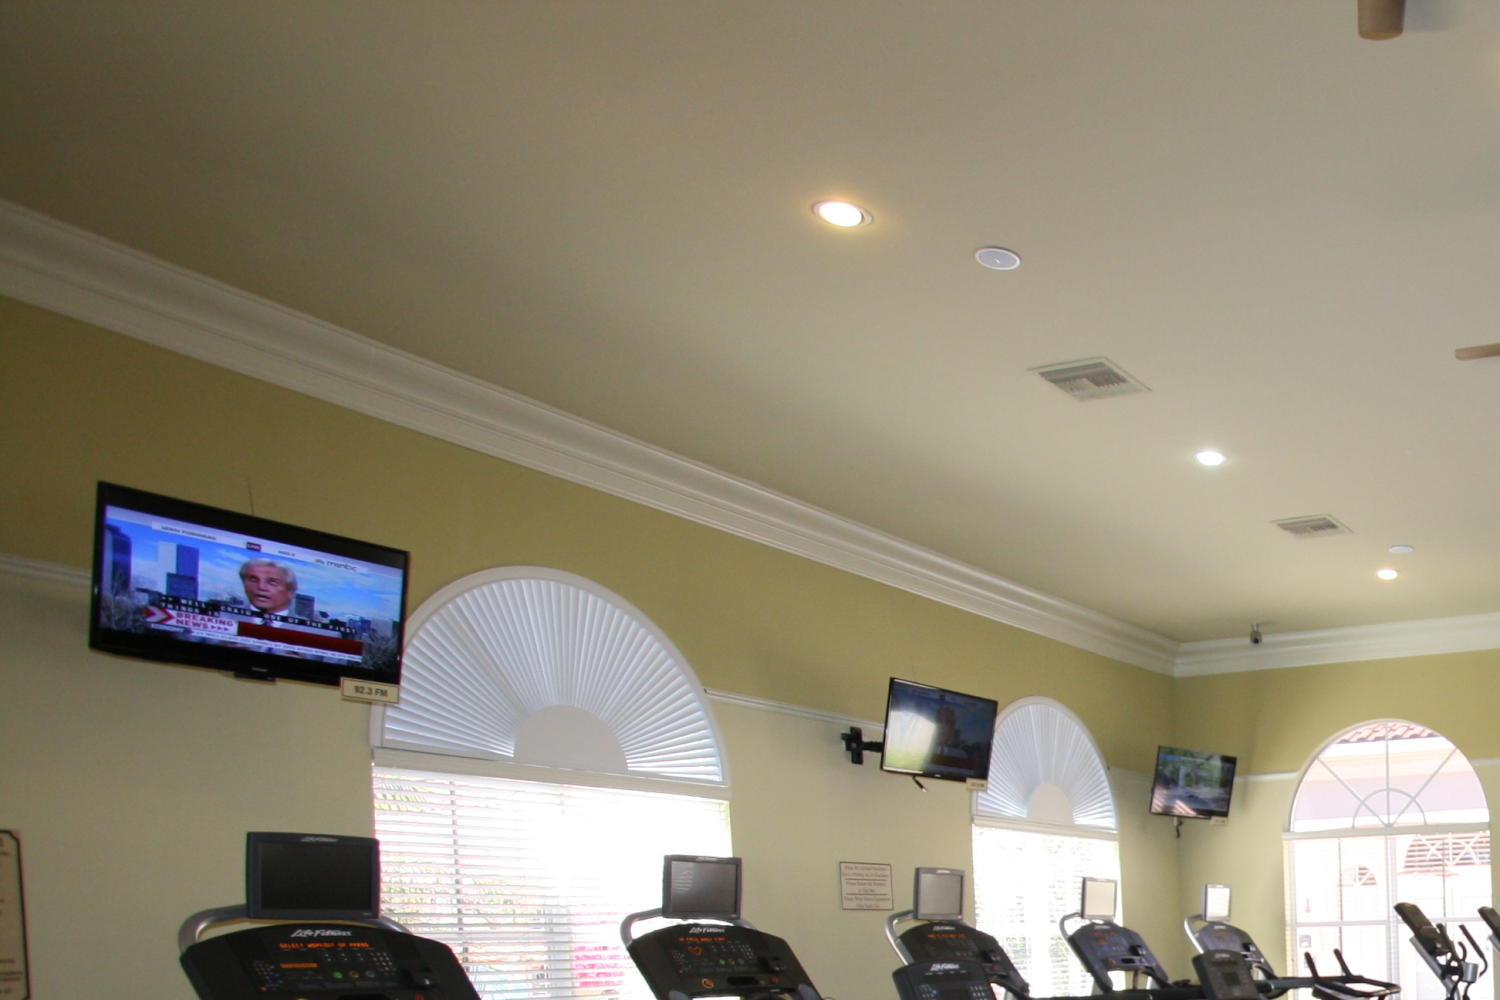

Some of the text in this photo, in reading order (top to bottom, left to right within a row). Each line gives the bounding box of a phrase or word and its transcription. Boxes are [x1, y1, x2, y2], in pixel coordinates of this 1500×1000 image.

[176, 611, 234, 627] BREAKING
[176, 619, 209, 629] NEWS
[374, 688, 388, 697] FM
